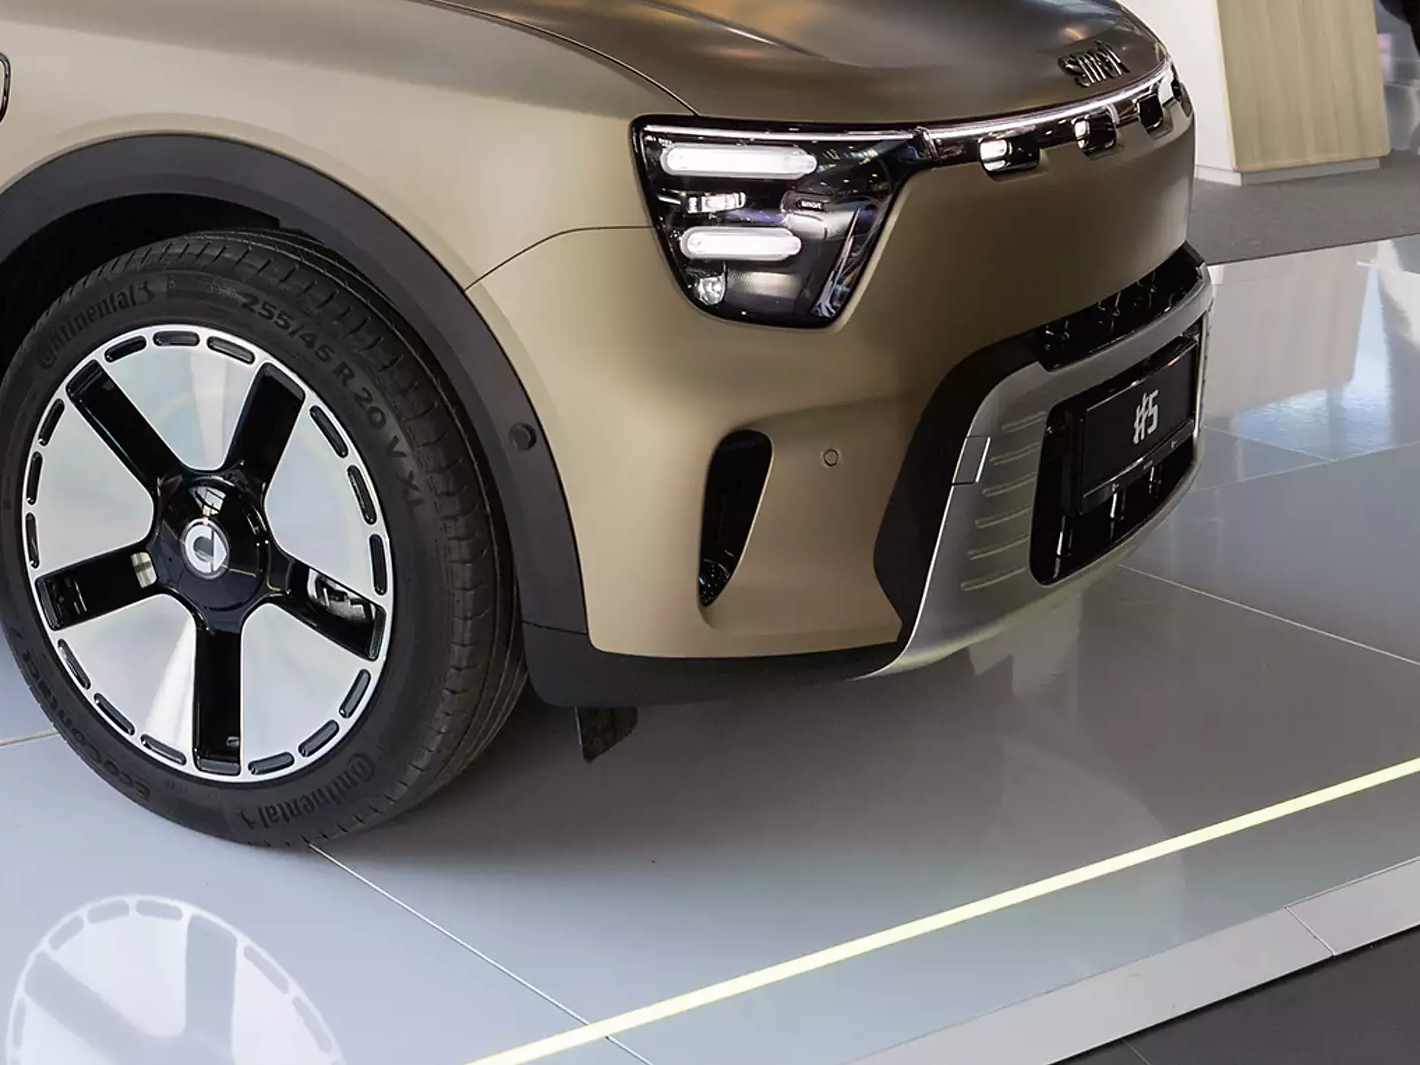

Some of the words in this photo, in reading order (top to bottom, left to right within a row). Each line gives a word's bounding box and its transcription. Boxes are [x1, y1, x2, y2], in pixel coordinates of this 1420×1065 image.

[38, 284, 137, 369] Continental
[235, 291, 337, 363] 255/45
[332, 361, 356, 387] R
[354, 387, 387, 430] 20
[258, 753, 377, 829] Continental
